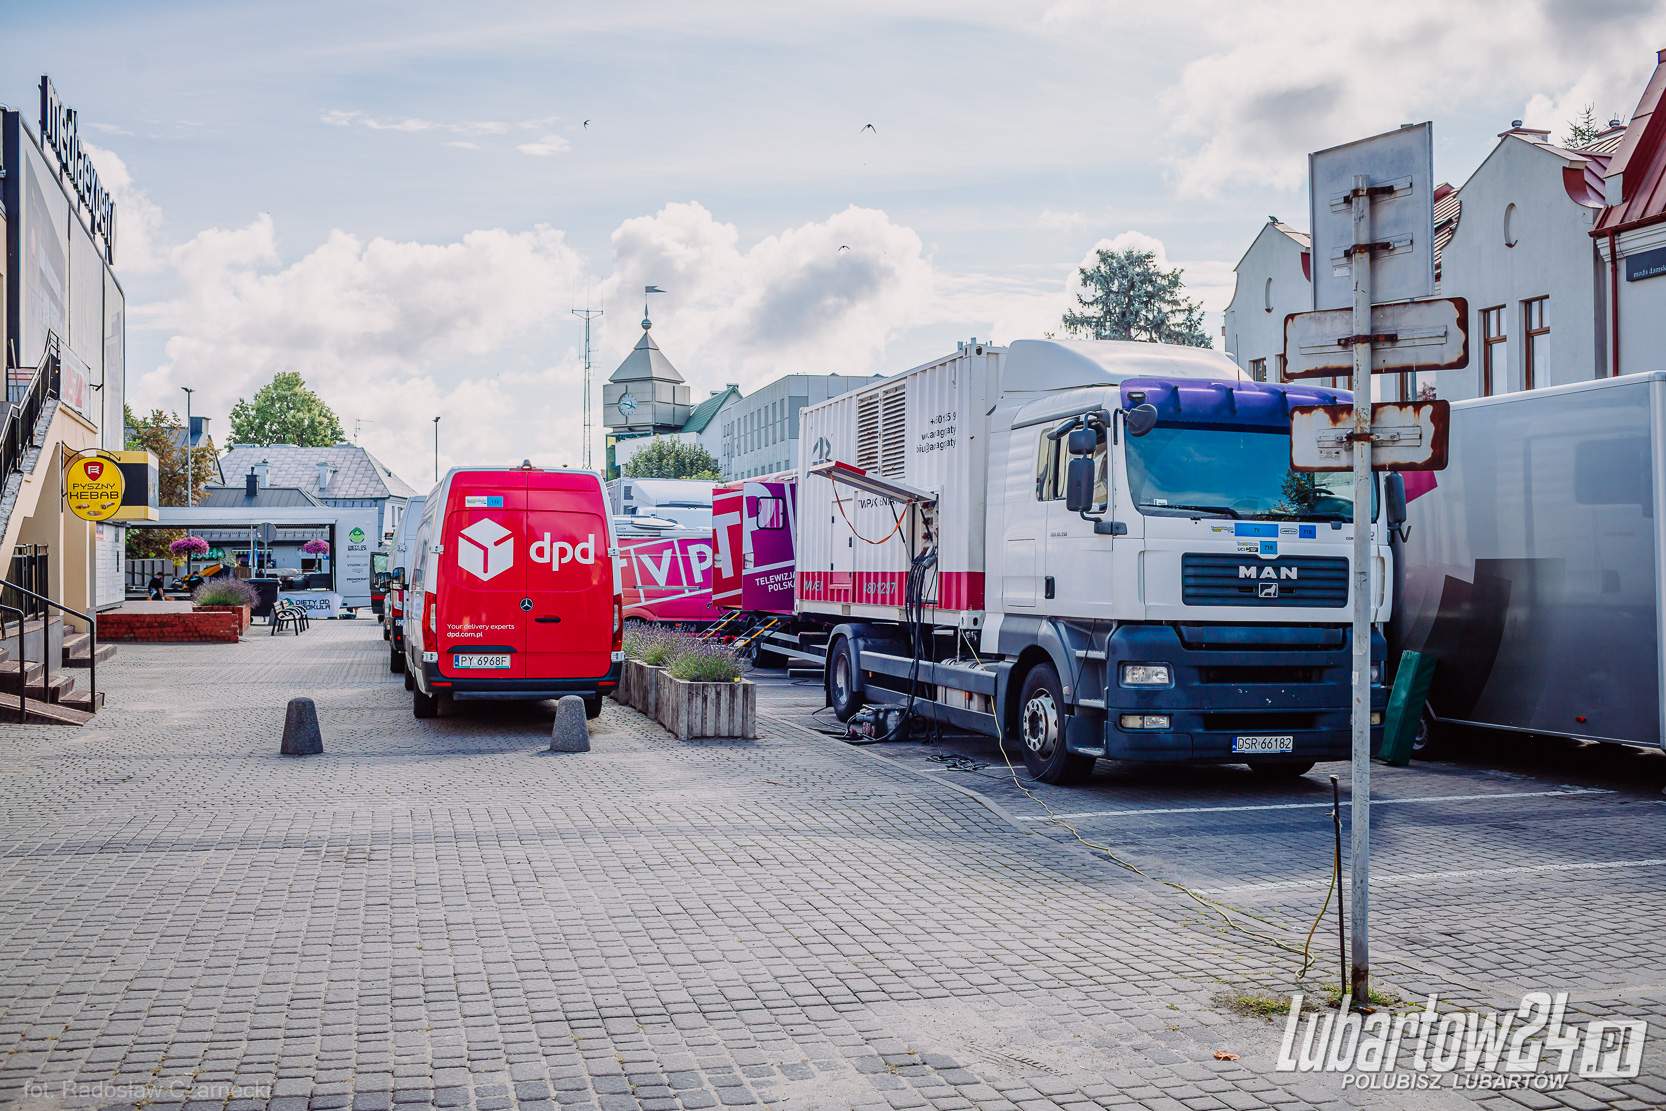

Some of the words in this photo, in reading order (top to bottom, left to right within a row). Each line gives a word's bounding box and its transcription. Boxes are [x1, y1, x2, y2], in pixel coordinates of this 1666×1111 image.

[69, 491, 119, 500] KEBAB
[529, 532, 595, 572] dpd
[1238, 565, 1298, 580] MAN
[464, 623, 489, 631] delivery
[460, 656, 474, 666] PY
[477, 656, 507, 666] 6968F
[1237, 737, 1258, 750] DSR
[1260, 737, 1292, 750] 66182
